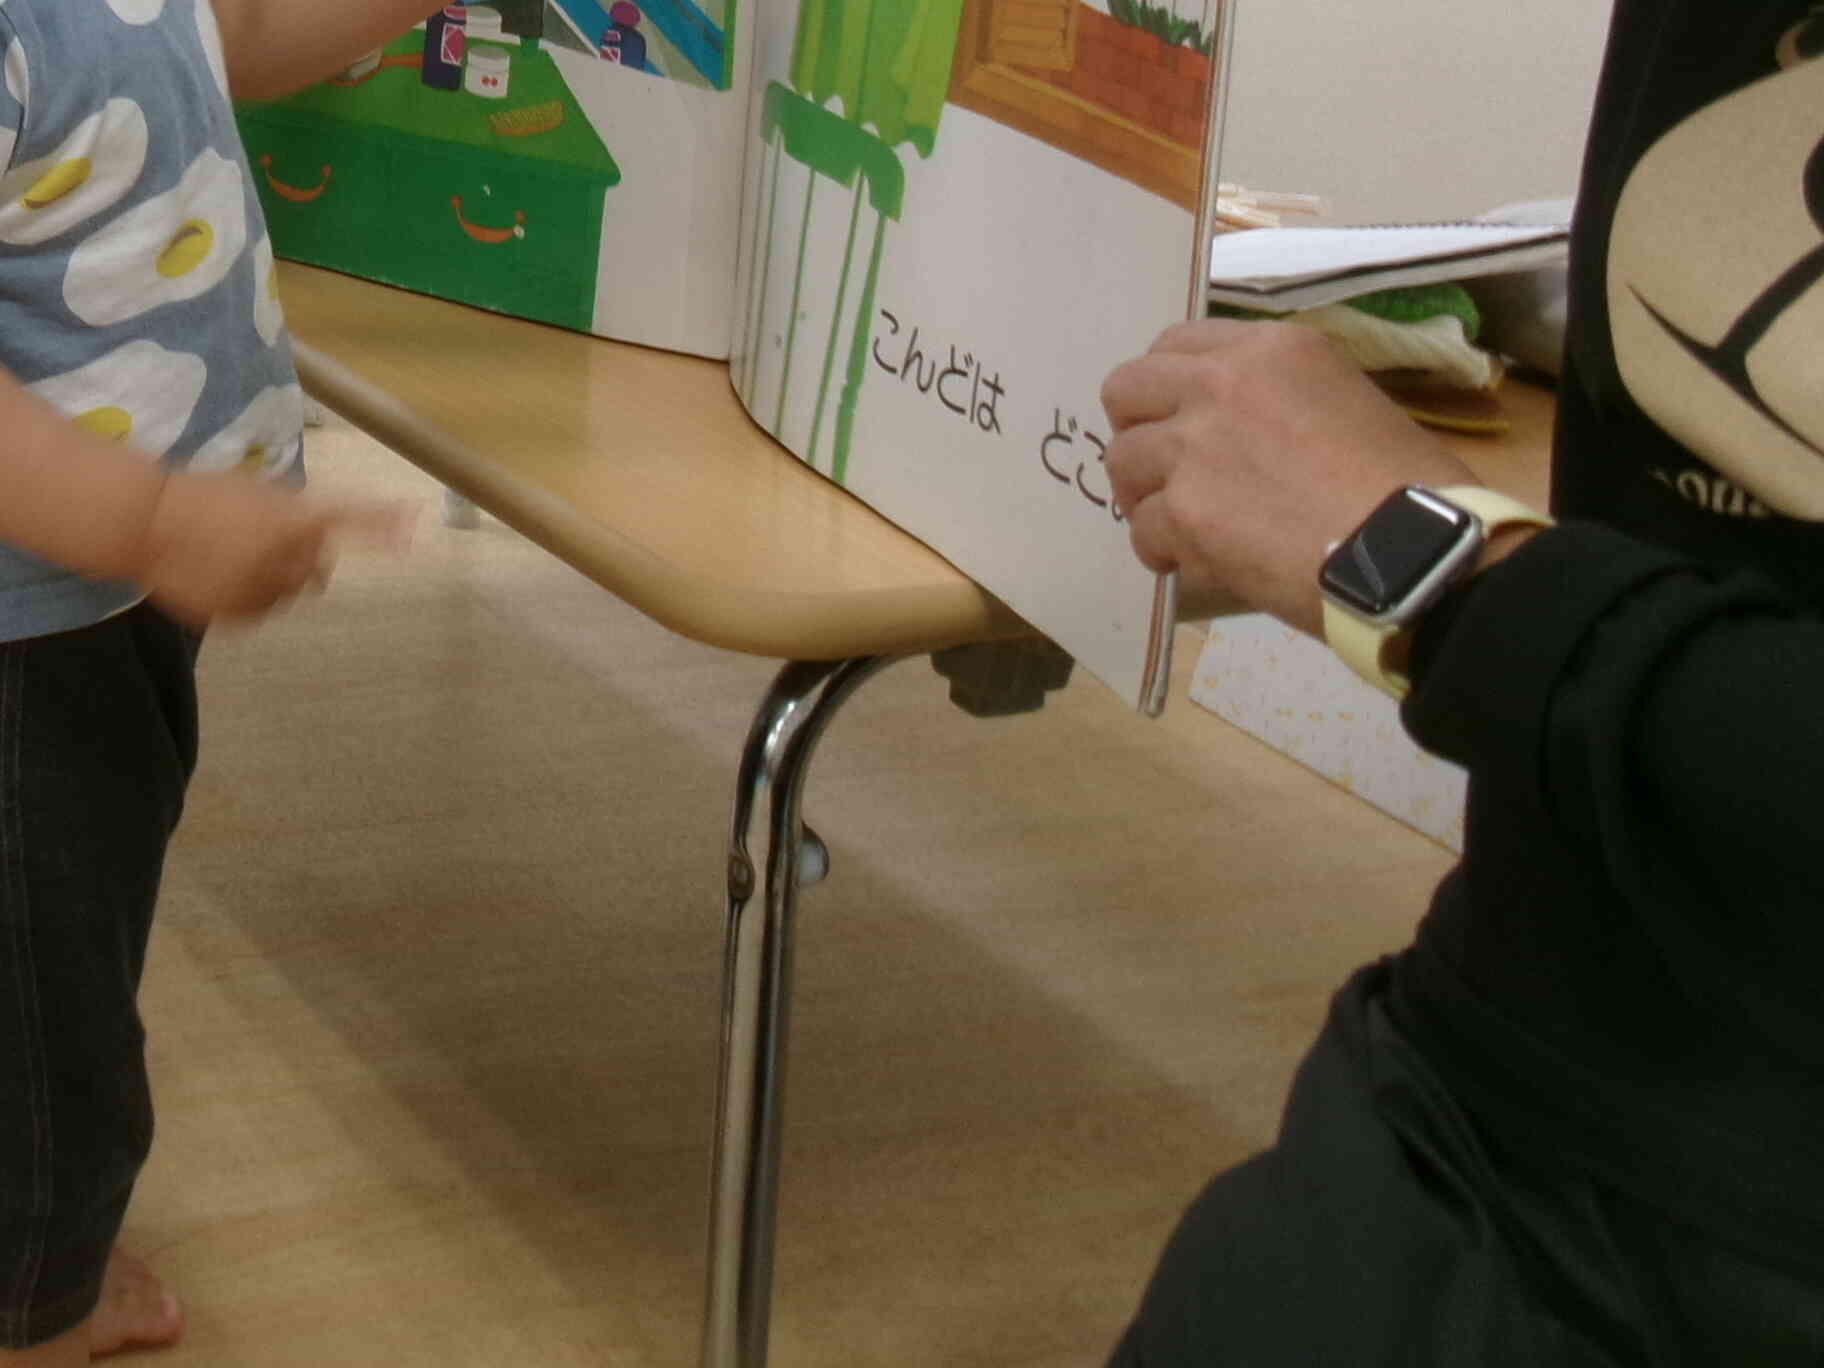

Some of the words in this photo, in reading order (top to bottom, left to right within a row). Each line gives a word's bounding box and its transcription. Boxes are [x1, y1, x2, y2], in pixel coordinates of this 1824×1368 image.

[872, 308, 1005, 435] こんどは
[1041, 407, 1127, 522] どこ
